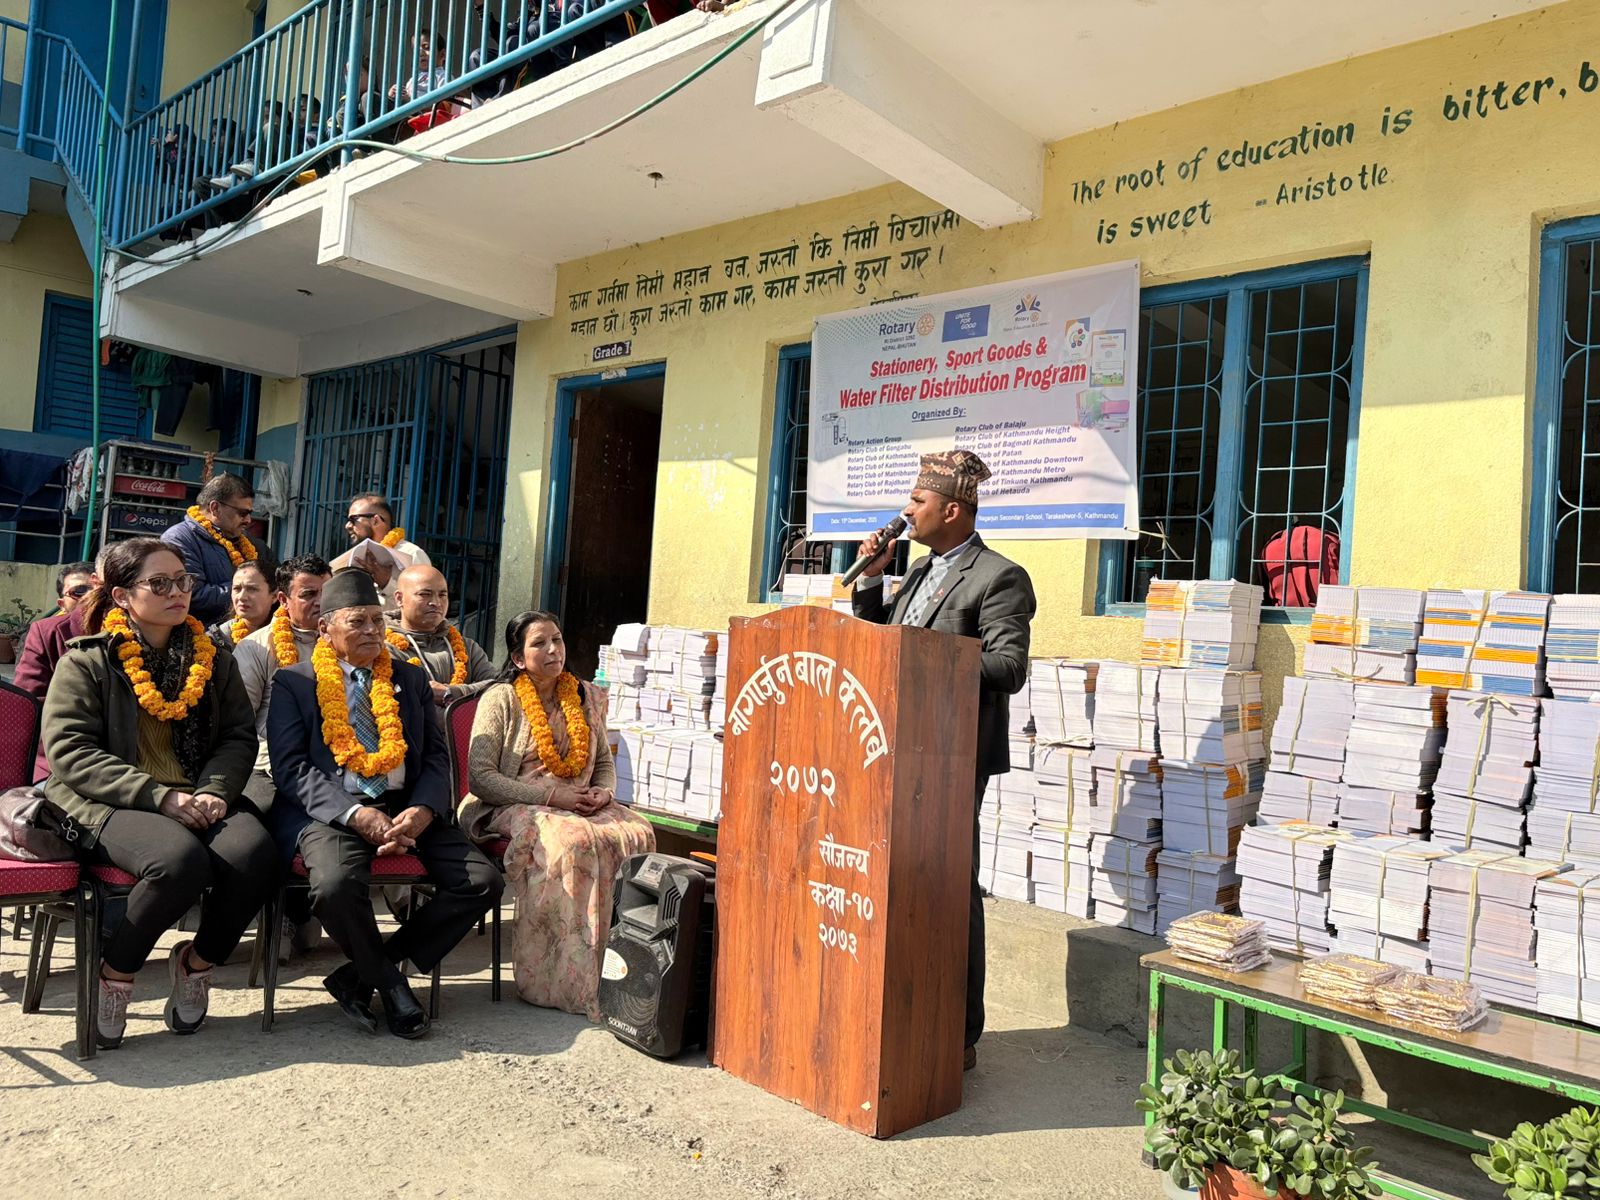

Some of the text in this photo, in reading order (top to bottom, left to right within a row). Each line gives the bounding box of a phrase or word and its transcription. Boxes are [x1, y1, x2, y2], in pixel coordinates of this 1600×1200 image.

[1072, 179, 1105, 204] The
[1116, 160, 1166, 194] root
[1177, 146, 1208, 182] of
[1216, 122, 1355, 172] education
[1381, 106, 1414, 136] is
[1443, 76, 1567, 121] bitter,
[1096, 219, 1118, 245] is
[1130, 199, 1212, 238] sweet
[569, 291, 592, 312] काम
[636, 270, 664, 299] तिमी
[756, 239, 799, 275] जस्तो
[810, 232, 833, 262] कि
[843, 221, 880, 256] तिमी
[630, 307, 653, 336] कुरा
[659, 291, 692, 322] जस्तो
[699, 291, 728, 315] काम
[763, 276, 800, 300] काम
[803, 260, 847, 296] जस्तो
[853, 256, 891, 294] कुरा
[900, 246, 931, 280] गर
[878, 319, 916, 337] Rotary
[594, 343, 623, 360] Grade
[869, 336, 1048, 379] Stationery, Sport Goods &
[839, 363, 1088, 409] Water Filter Distribution Program
[911, 405, 967, 421] Organized By:
[955, 421, 1026, 433] Rotary Club of Balaju
[955, 426, 1071, 443] Rotary Club of Kathmandu Height
[977, 442, 992, 450] Club
[993, 440, 1002, 448] of
[1002, 438, 1031, 449] Bagmati
[1033, 436, 1077, 445] Kathmandu
[885, 452, 918, 460] Kathmandu
[994, 449, 1002, 458] of
[1002, 449, 1022, 457] Patan
[1001, 457, 1042, 467] Kathmandu
[1044, 456, 1084, 465] Downtown
[885, 461, 918, 469] Kathmandu
[992, 466, 1066, 477] of Kathmandu Metro
[992, 478, 1000, 486] of
[1000, 477, 1029, 486] Tinkune
[1029, 475, 1073, 485] Kathmandu
[991, 487, 999, 496] of
[999, 487, 1030, 495] Hetauda
[139, 517, 168, 526] pepsi
[999, 514, 1025, 522] Secondary
[1084, 511, 1119, 520] Kathmandu
[728, 654, 795, 736] नागार्जुन
[793, 652, 837, 698] बाल
[770, 761, 836, 808] २०७२
[818, 832, 871, 878] सौजन्य
[818, 922, 859, 964] २०७३
